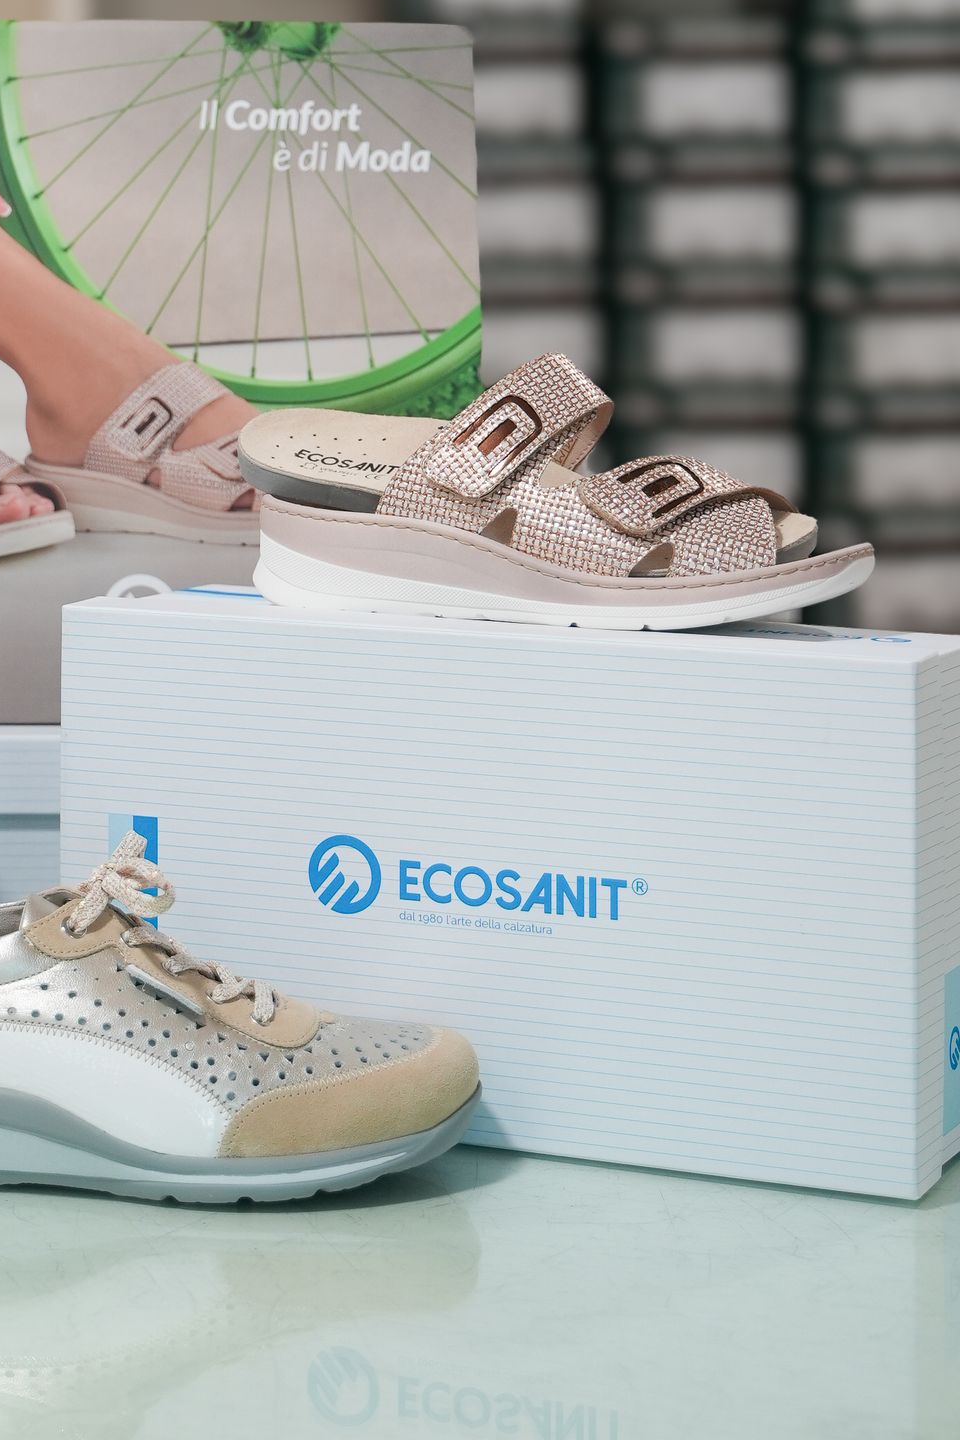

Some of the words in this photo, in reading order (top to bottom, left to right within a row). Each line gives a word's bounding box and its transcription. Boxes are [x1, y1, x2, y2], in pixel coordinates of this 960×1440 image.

[199, 99, 219, 131] Il
[224, 99, 362, 136] Comfort
[273, 141, 291, 172] è
[298, 141, 328, 172] di
[335, 141, 431, 173] Moda
[294, 448, 401, 475] ECOSANIT
[399, 910, 416, 921] dal
[418, 913, 443, 925] 1980
[446, 915, 472, 927] l'arte
[474, 918, 501, 930] della
[503, 921, 553, 935] calzatura
